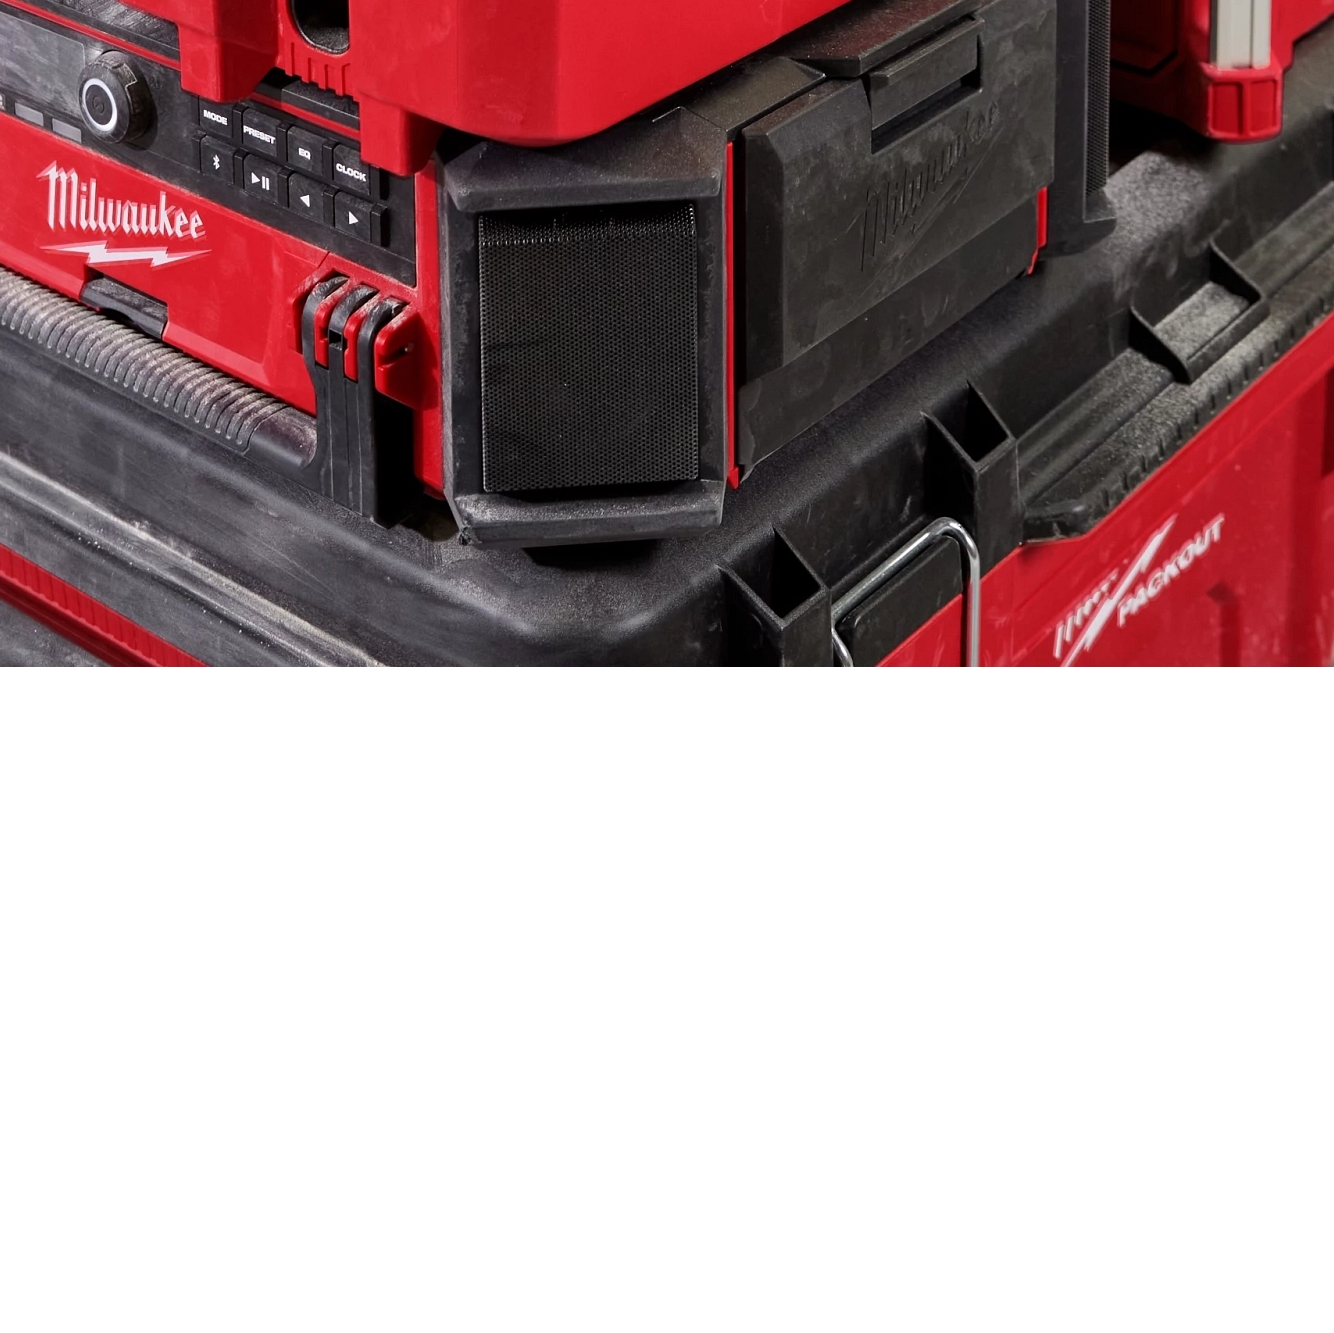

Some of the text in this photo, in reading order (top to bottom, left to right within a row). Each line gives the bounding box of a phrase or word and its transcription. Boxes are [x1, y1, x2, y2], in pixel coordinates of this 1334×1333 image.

[203, 109, 228, 126] MODE
[243, 124, 276, 145] PRESET
[298, 147, 312, 161] EQ
[335, 162, 367, 183] CLOCK
[36, 159, 207, 241] Milwaukee
[1117, 513, 1225, 629] PACKOUT
